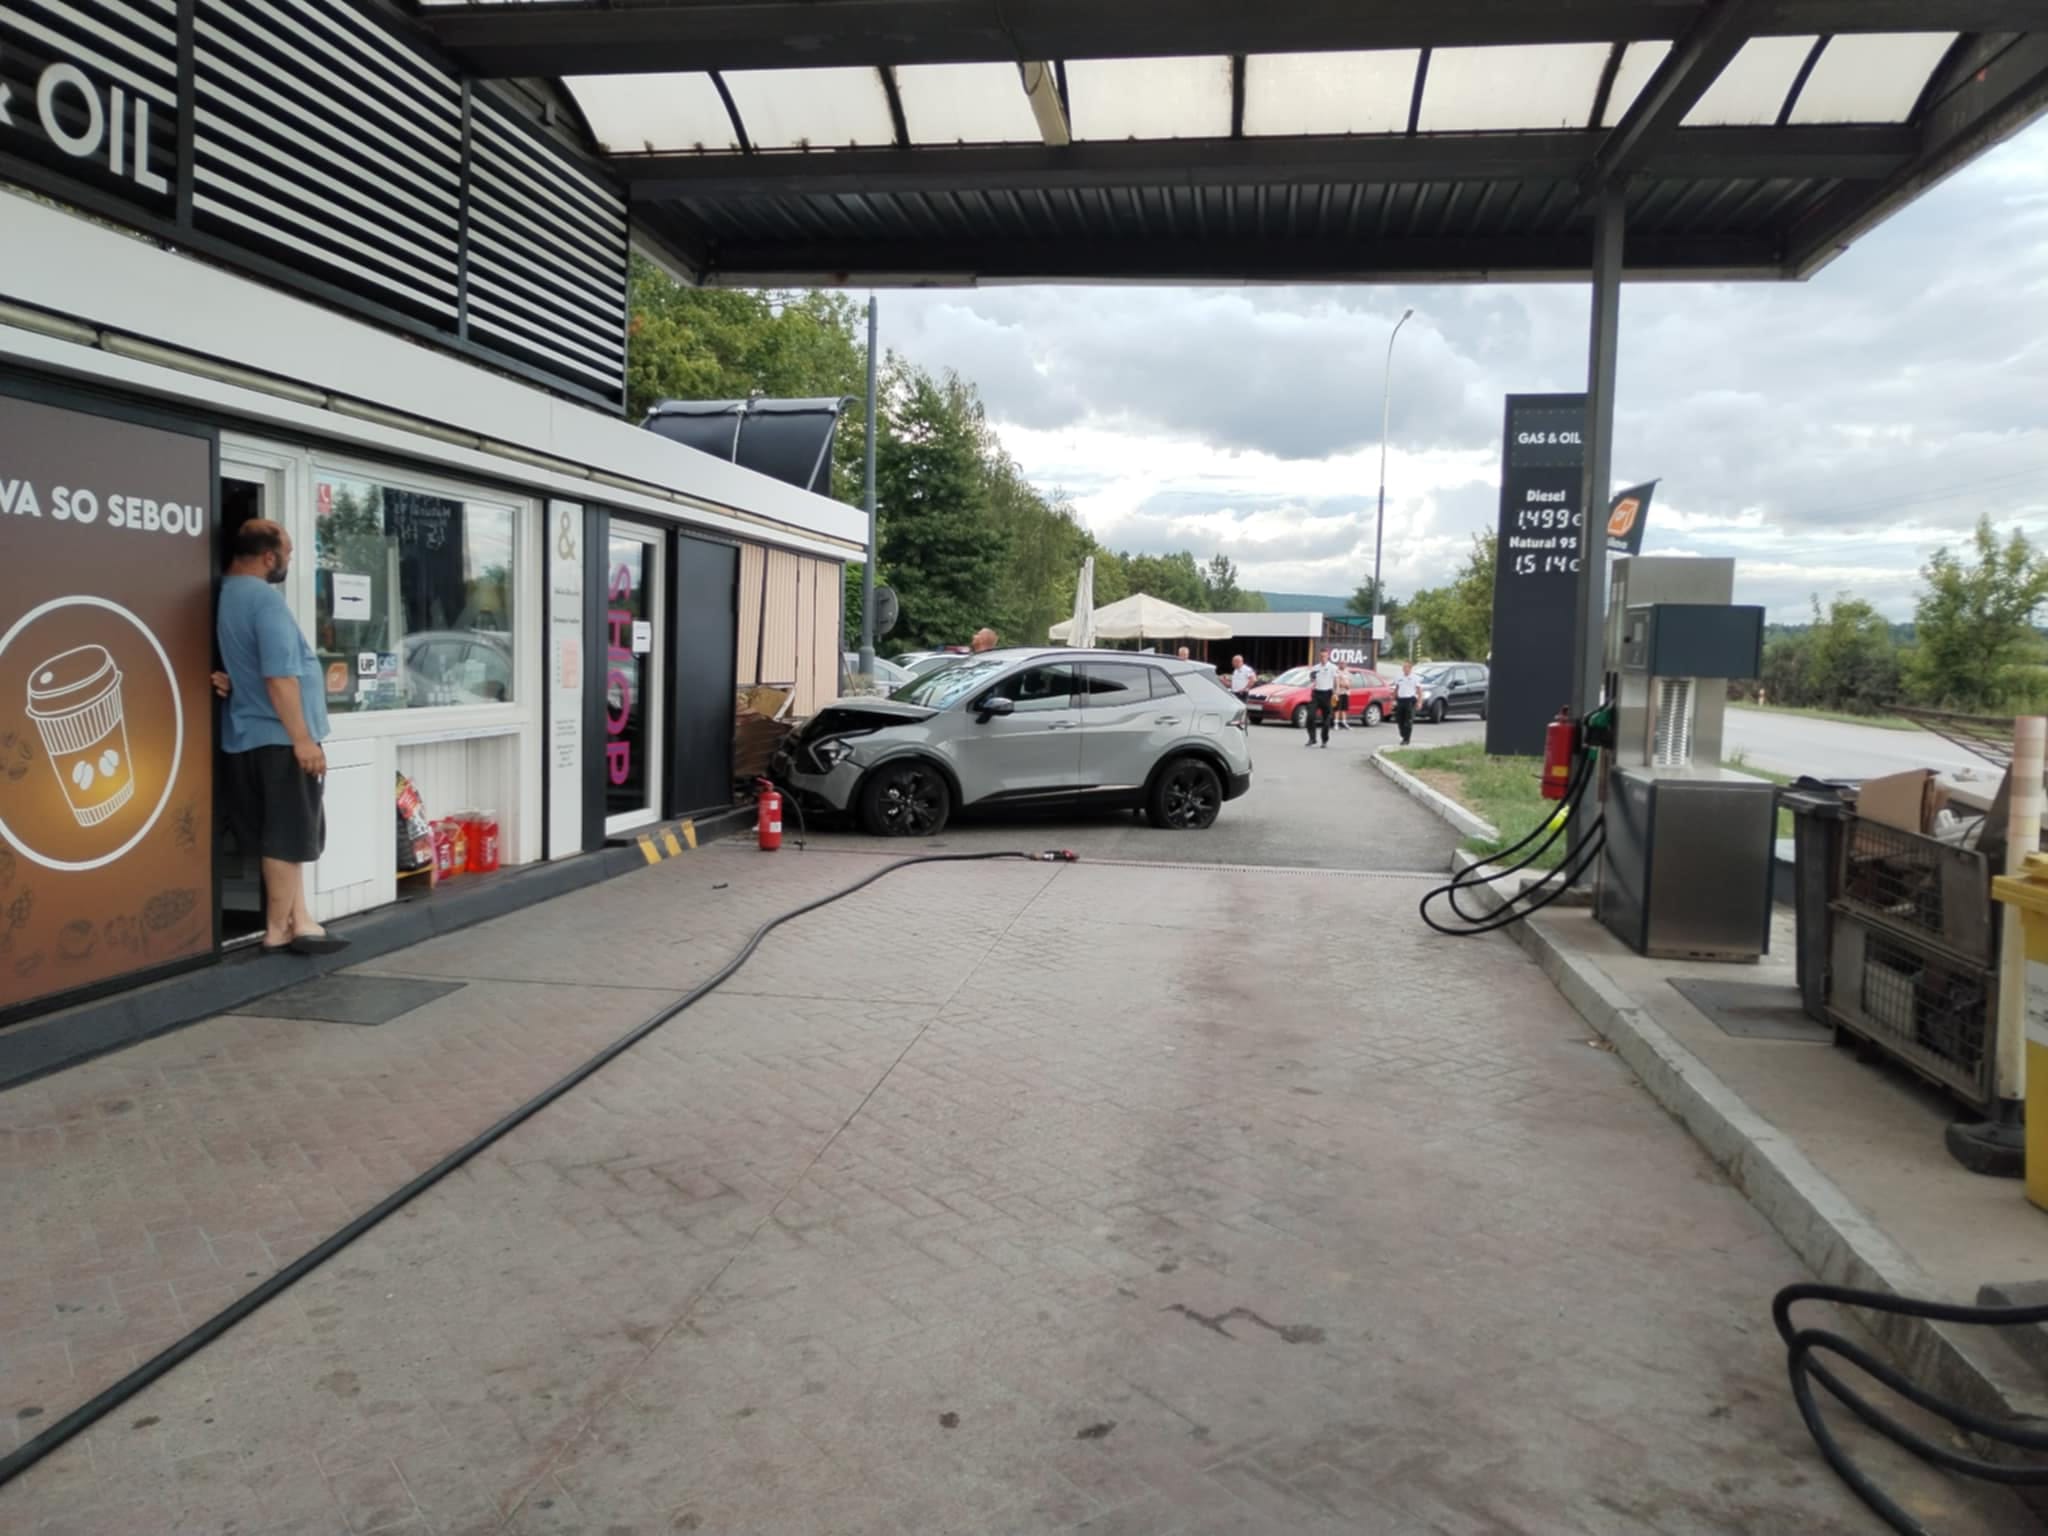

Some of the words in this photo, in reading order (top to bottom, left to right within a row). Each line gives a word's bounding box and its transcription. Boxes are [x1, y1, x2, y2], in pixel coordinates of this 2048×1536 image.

[37, 62, 168, 194] OIL
[1518, 432, 1545, 444] GAS
[1547, 432, 1557, 444] &
[1559, 432, 1582, 444] OIL
[1526, 489, 1566, 502] Diesel
[51, 486, 98, 524] SO
[107, 494, 203, 536] SEBOU
[1509, 536, 1557, 548] Natural
[1559, 536, 1577, 549] 95
[360, 658, 375, 672] UP
[607, 563, 632, 785] SHOP
